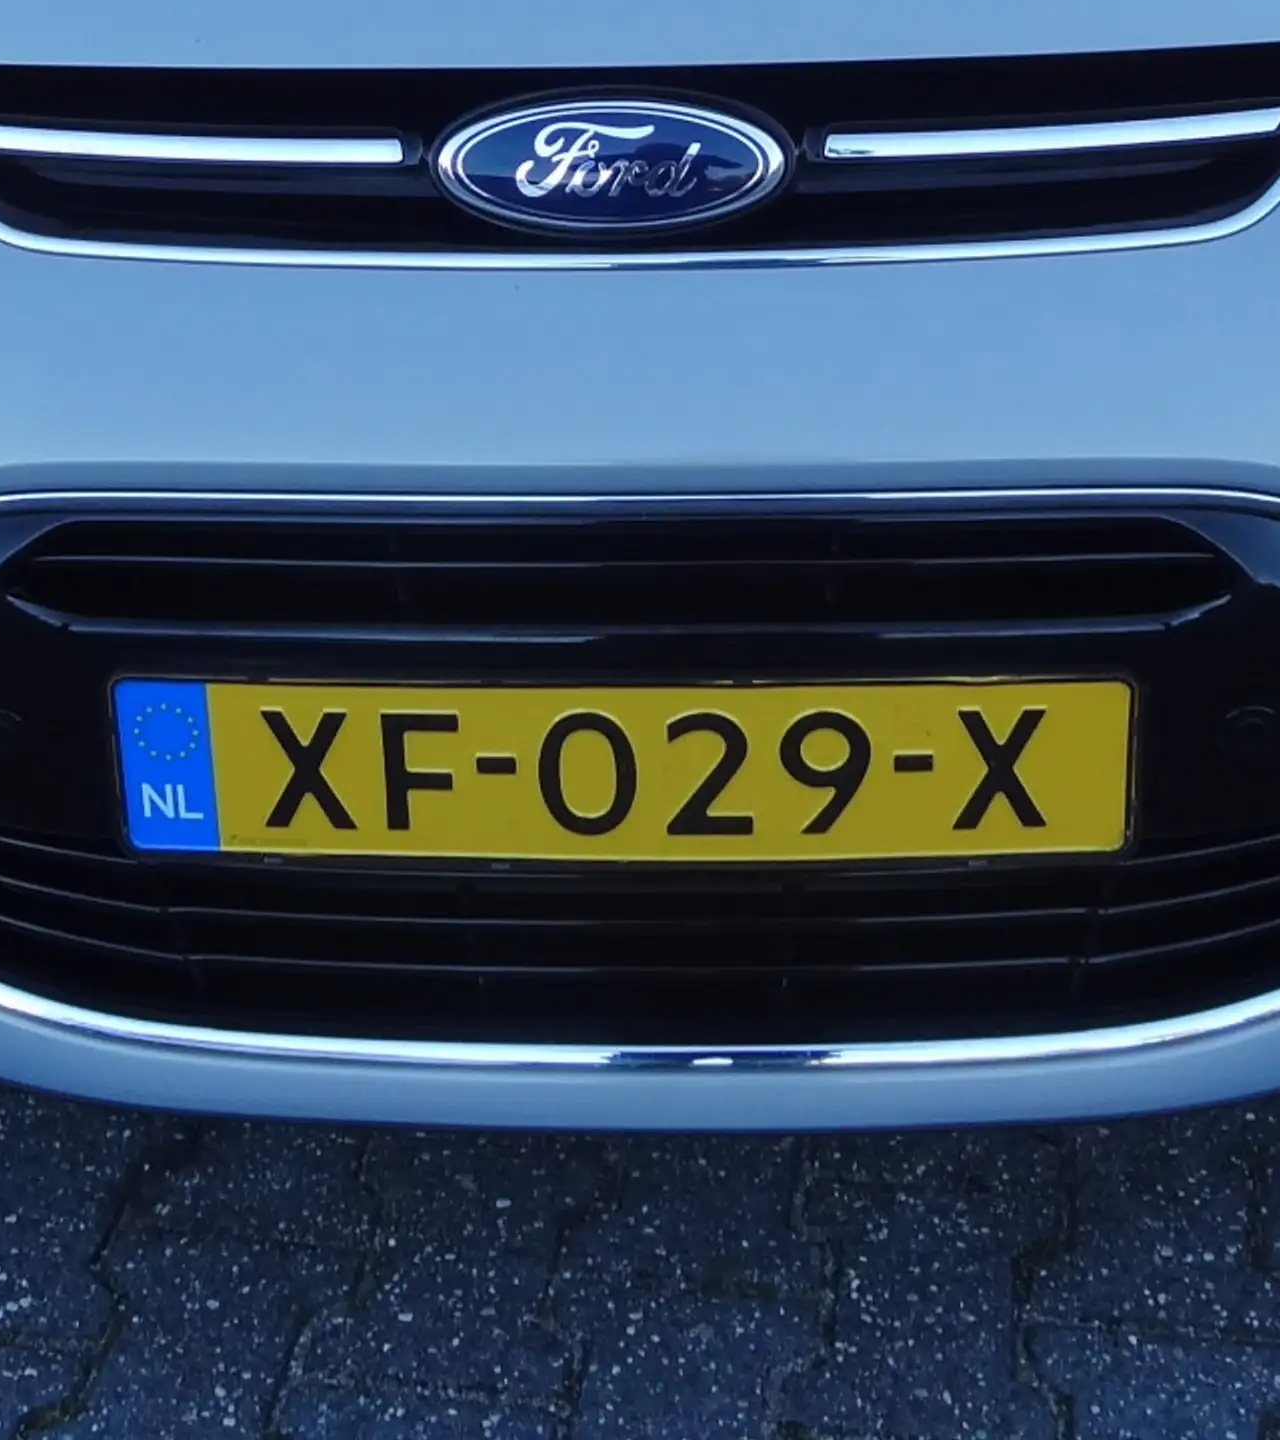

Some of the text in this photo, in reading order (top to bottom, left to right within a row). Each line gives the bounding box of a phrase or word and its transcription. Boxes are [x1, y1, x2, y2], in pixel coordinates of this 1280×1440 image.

[516, 121, 701, 198] Ford
[141, 782, 204, 820] NL
[260, 709, 1048, 837] XF-029-X
